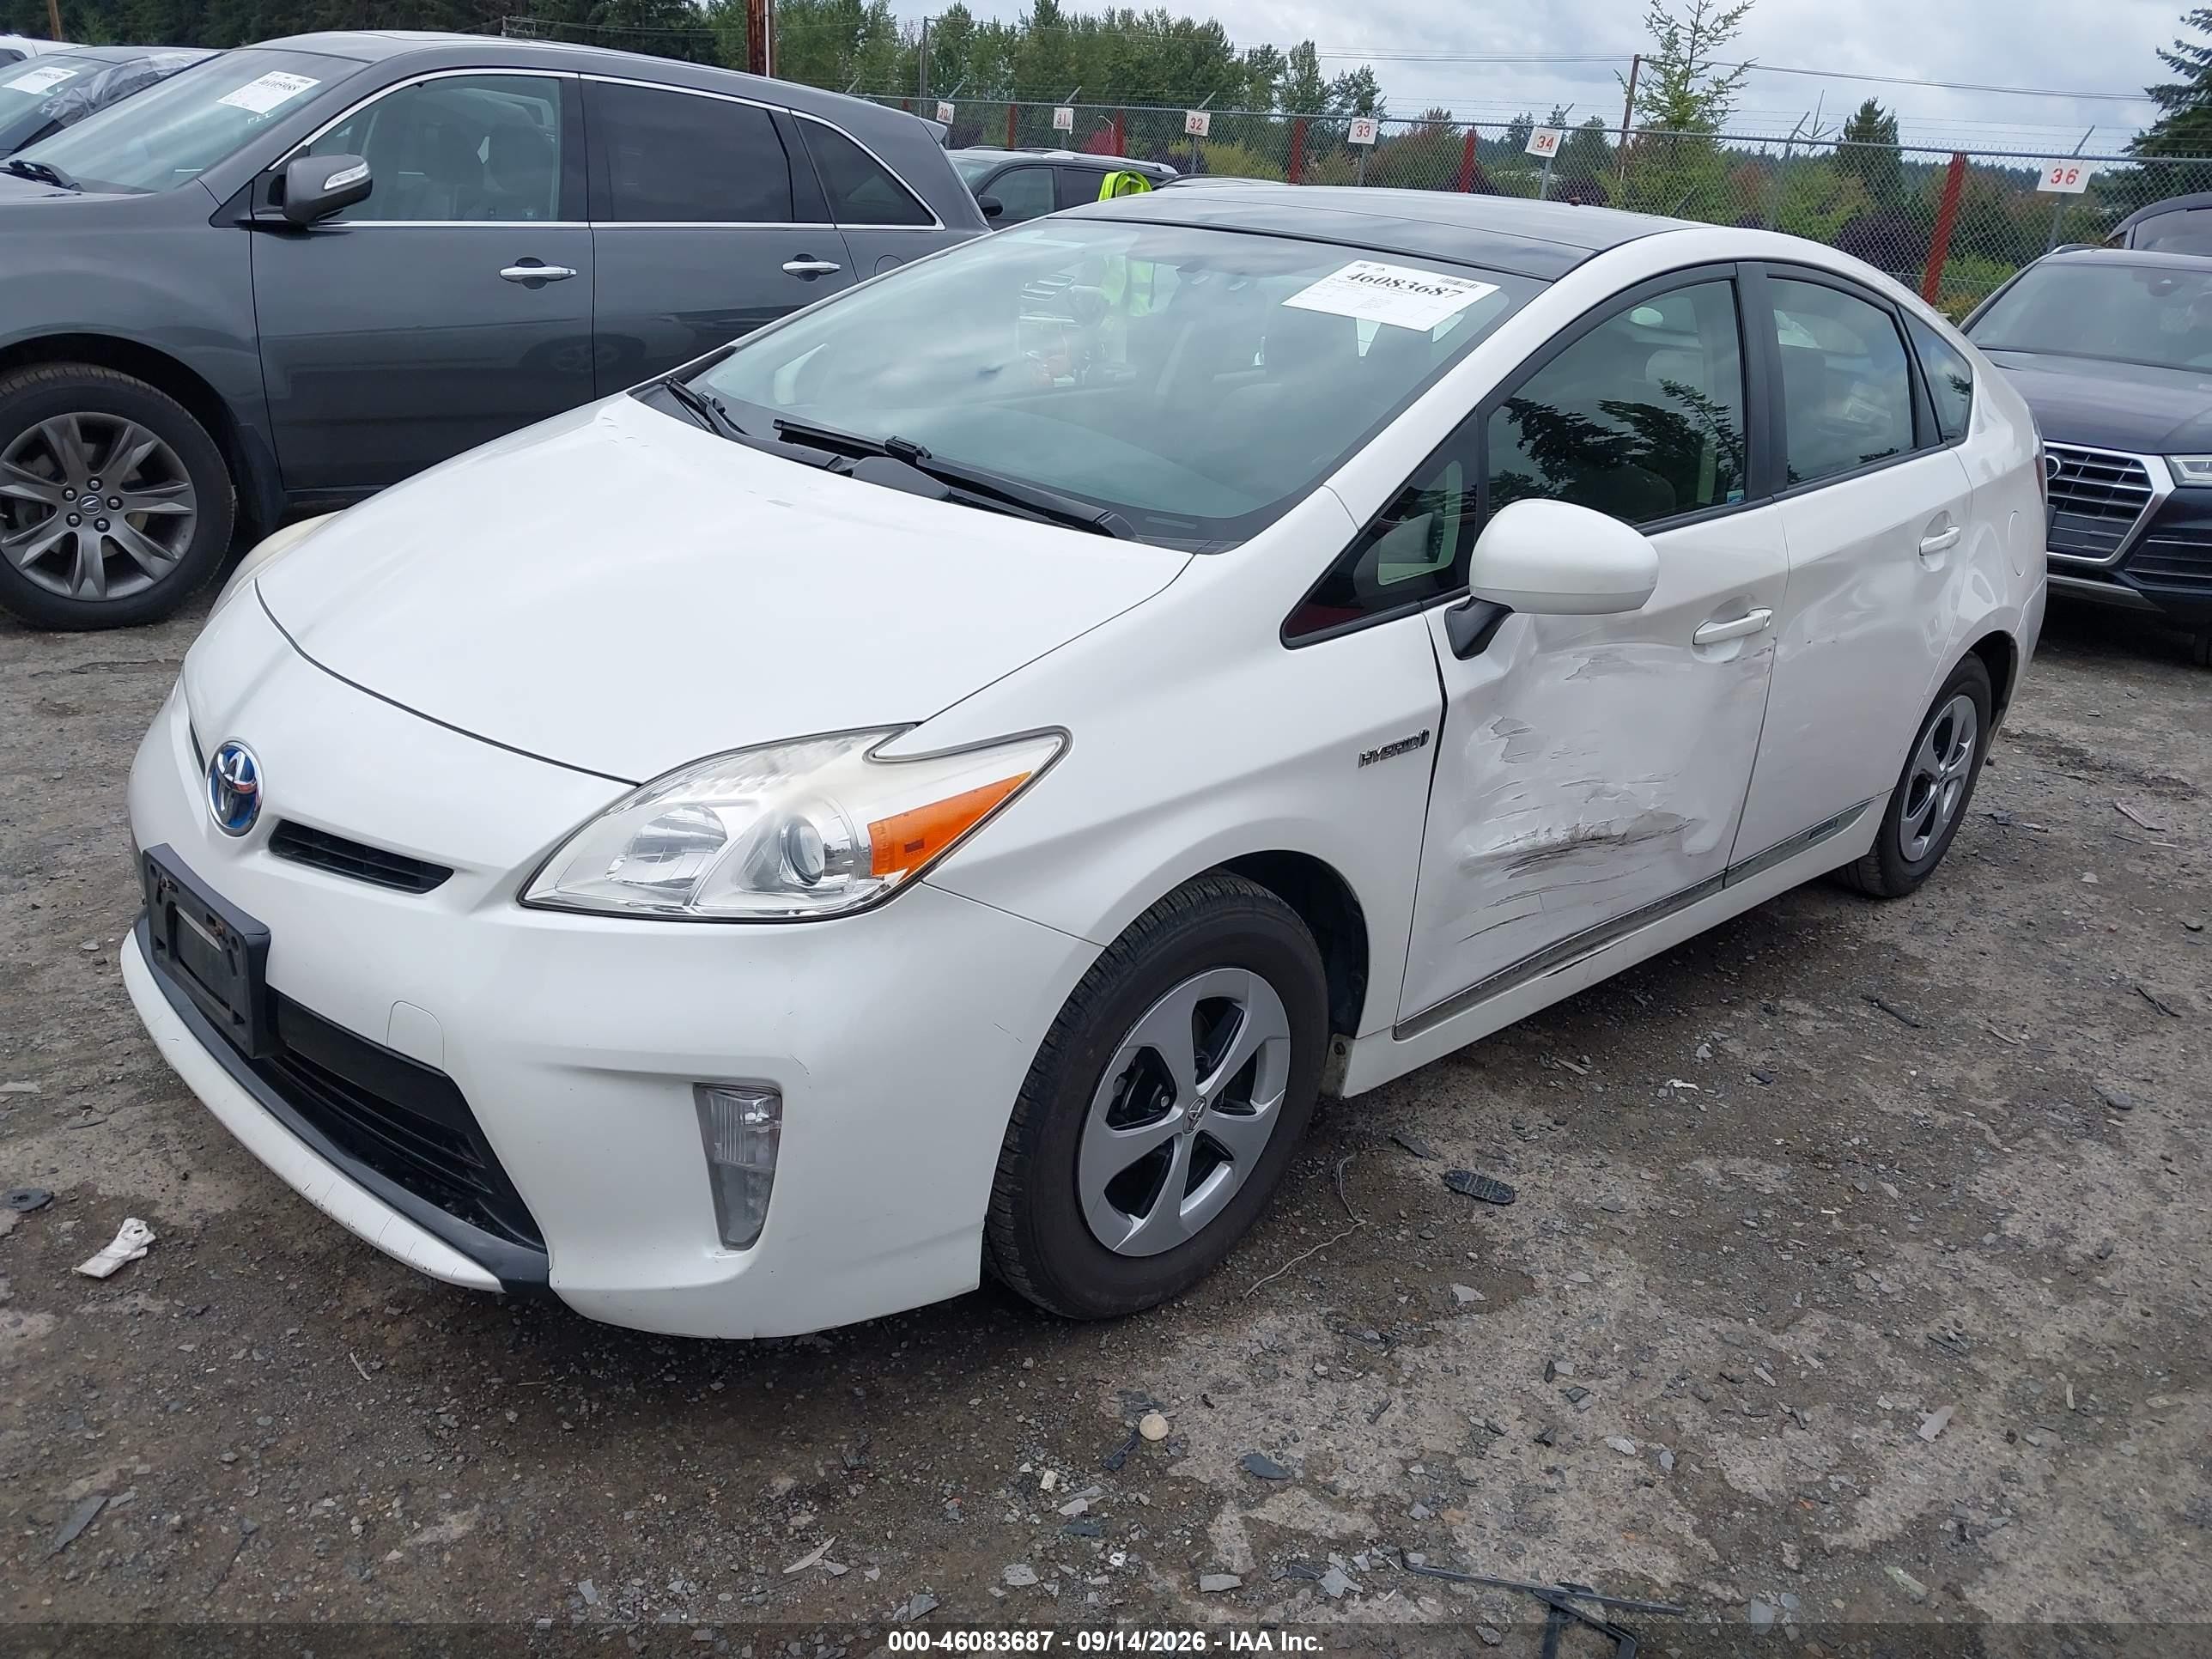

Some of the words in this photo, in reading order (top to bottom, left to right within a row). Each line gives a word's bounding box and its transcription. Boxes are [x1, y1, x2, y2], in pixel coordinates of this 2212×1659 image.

[1057, 113, 1066, 125] 31
[1190, 117, 1203, 130] 32
[1357, 125, 1370, 137] 33
[1537, 135, 1554, 150] 34
[2051, 168, 2079, 185] 36
[1346, 272, 1464, 299] 46083687
[1358, 728, 1430, 769] HYBRID
